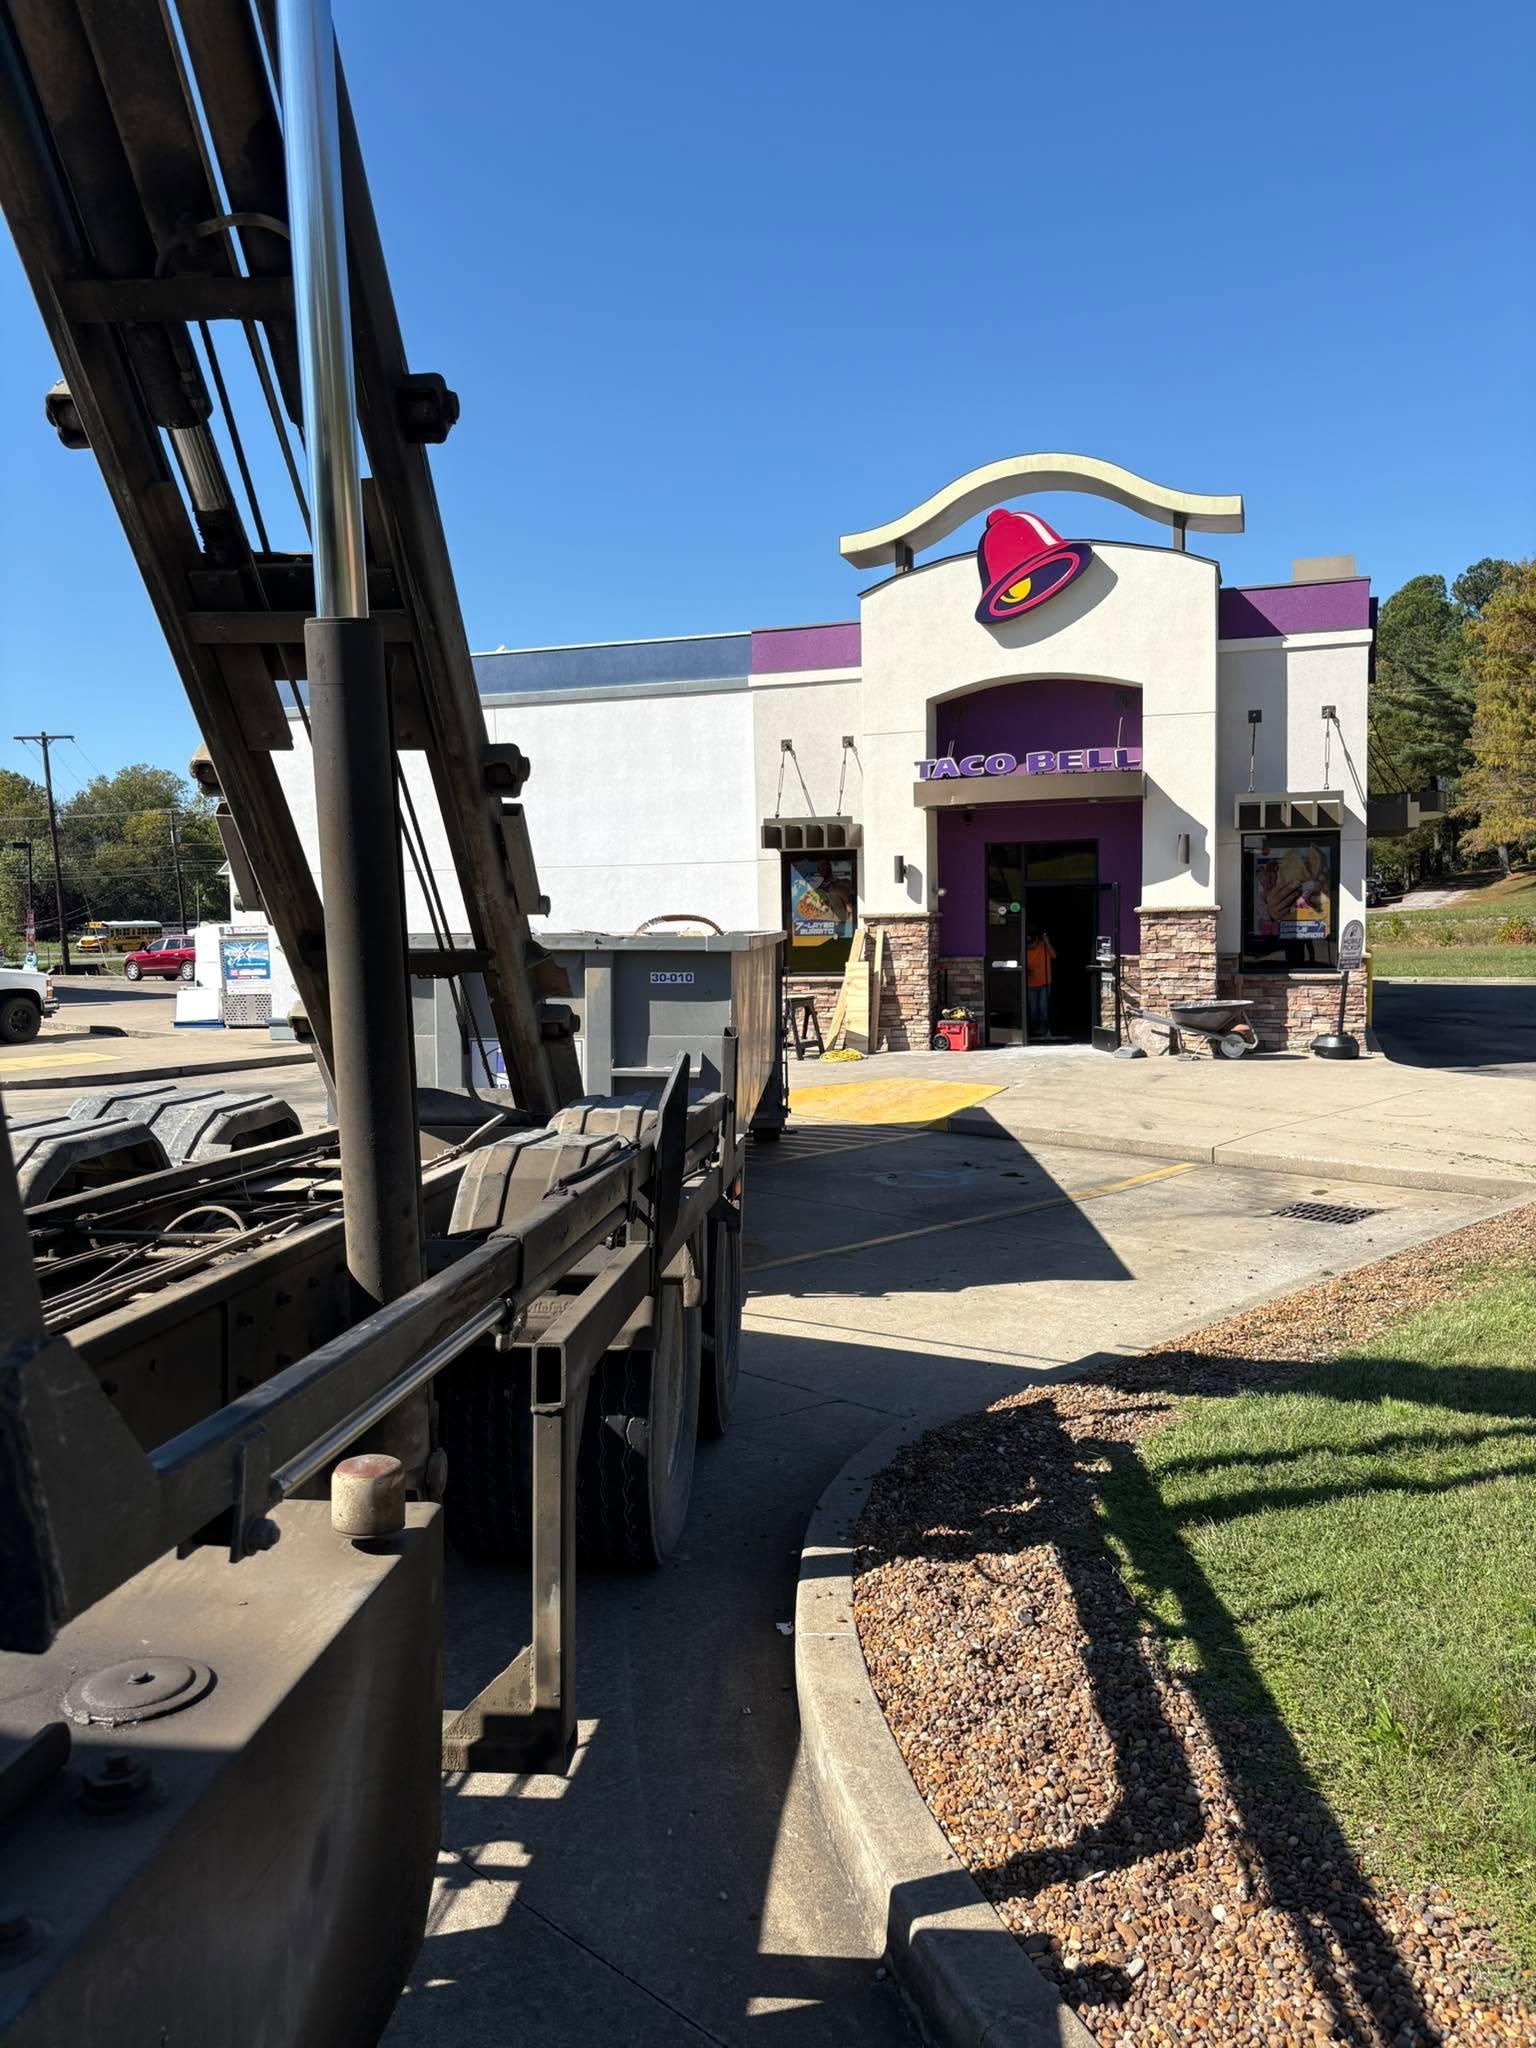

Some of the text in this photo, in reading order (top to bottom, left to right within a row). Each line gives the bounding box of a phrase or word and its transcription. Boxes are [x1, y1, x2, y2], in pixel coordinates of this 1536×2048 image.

[914, 748, 1141, 780] TACO BELL
[651, 973, 693, 982] 30-010
